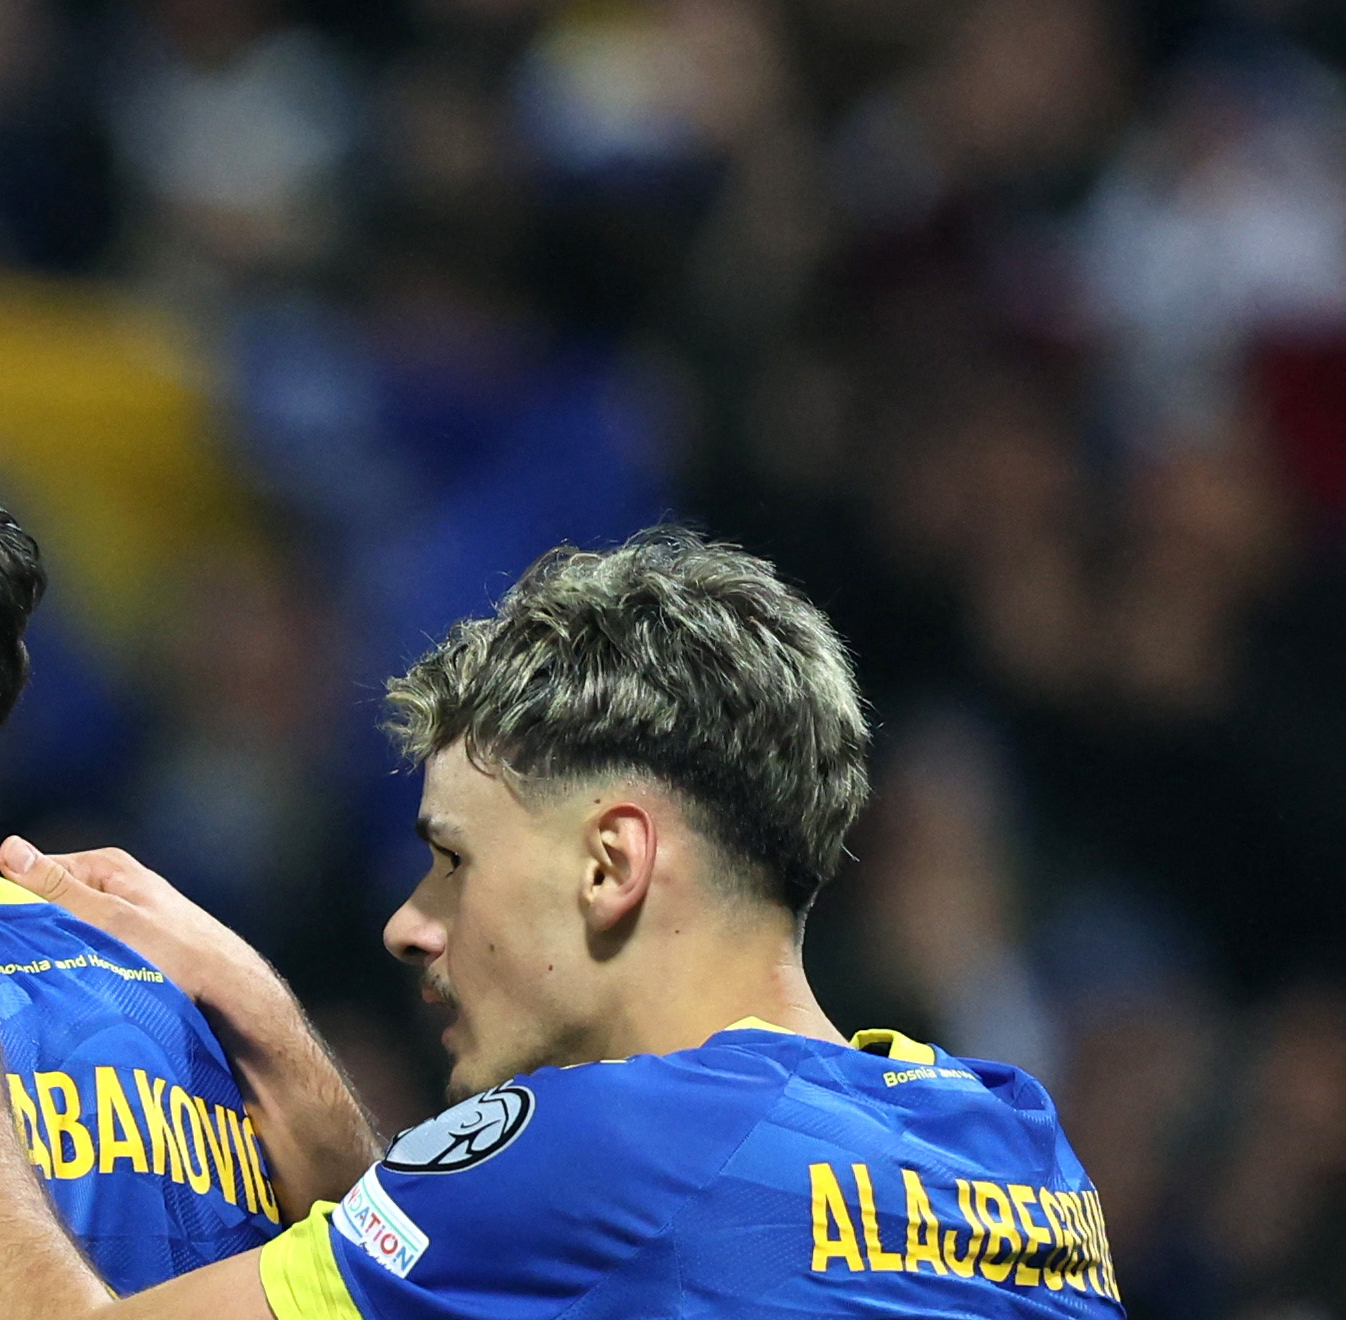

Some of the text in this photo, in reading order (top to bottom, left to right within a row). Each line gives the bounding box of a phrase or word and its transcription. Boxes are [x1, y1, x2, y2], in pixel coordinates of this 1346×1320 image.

[5, 1066, 280, 1224] ABAKOVI
[883, 1066, 937, 1088] Bosnia
[809, 1163, 1121, 1302] ALAJBEGOVI
